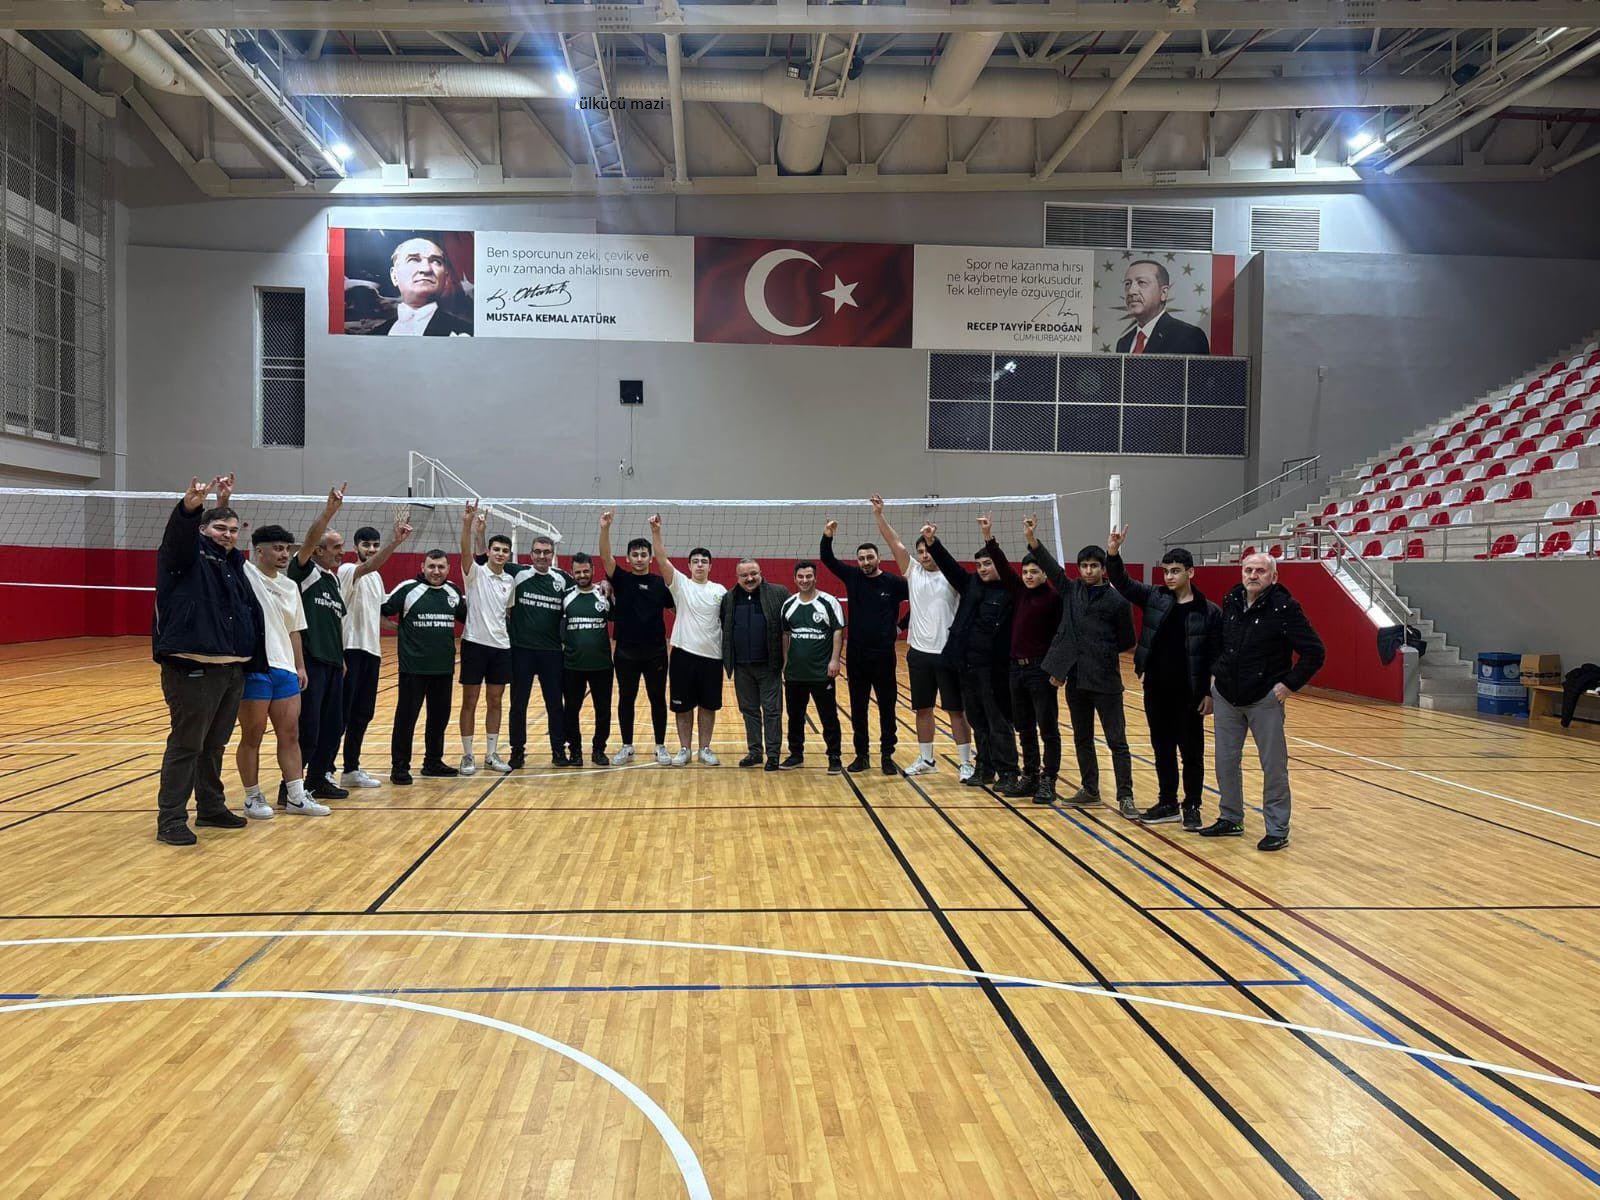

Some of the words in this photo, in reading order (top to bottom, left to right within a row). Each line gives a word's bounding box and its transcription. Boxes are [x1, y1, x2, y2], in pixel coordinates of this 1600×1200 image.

[487, 246, 509, 258] Ben
[512, 248, 573, 261] sporcunun
[576, 248, 601, 261] zeki,
[604, 250, 633, 262] çevik
[635, 252, 649, 262] ve
[486, 263, 510, 276] aynı
[513, 264, 566, 275] zamanda
[568, 264, 623, 277] ahlaklısını
[625, 266, 673, 278] severim.
[966, 258, 992, 272] Spor
[994, 260, 1009, 271] ne
[1011, 258, 1059, 272] kazanma
[1062, 260, 1084, 273] hırsı
[963, 271, 1018, 285] kaybetme
[1021, 273, 1084, 286] korkusudur.
[946, 284, 965, 296] Tek
[967, 284, 1018, 300] kelimeyle
[1021, 286, 1084, 300] özgüvendir.
[486, 313, 532, 322] MUSTAFA
[535, 314, 569, 323] KEMAL
[571, 312, 617, 324] ATATÜRK
[967, 322, 998, 331] RECEP
[1000, 320, 1033, 332] TAYYİP
[1034, 322, 1082, 333] ERDOĞAN
[1013, 333, 1082, 344] CUMHURBAŞKANI
